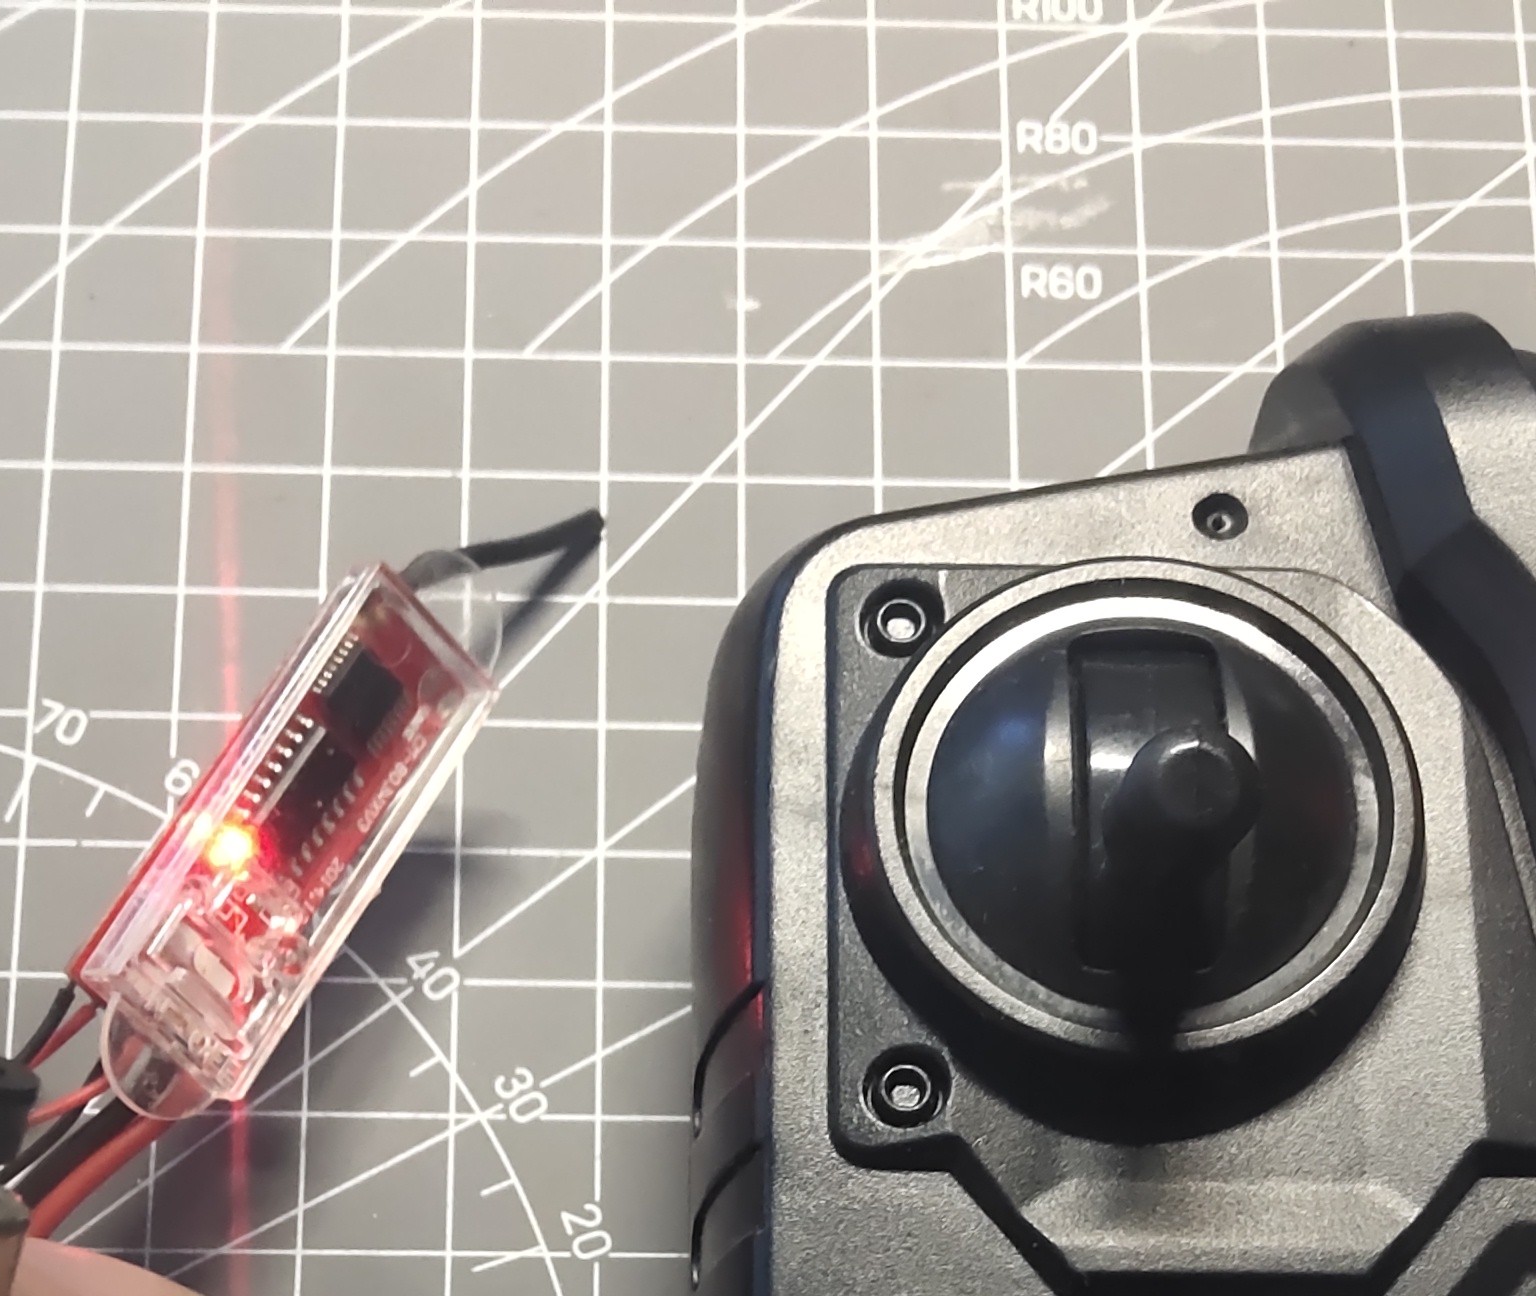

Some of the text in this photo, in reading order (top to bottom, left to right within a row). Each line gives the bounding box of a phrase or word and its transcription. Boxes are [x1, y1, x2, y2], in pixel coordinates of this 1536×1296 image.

[1010, 0, 1104, 25] R100
[1015, 119, 1099, 156] R80
[1020, 262, 1104, 301] R60
[31, 696, 90, 746] 70
[165, 760, 200, 795] 6
[404, 949, 462, 1002] 40
[493, 1066, 549, 1123] 30
[561, 1202, 612, 1260] 20
